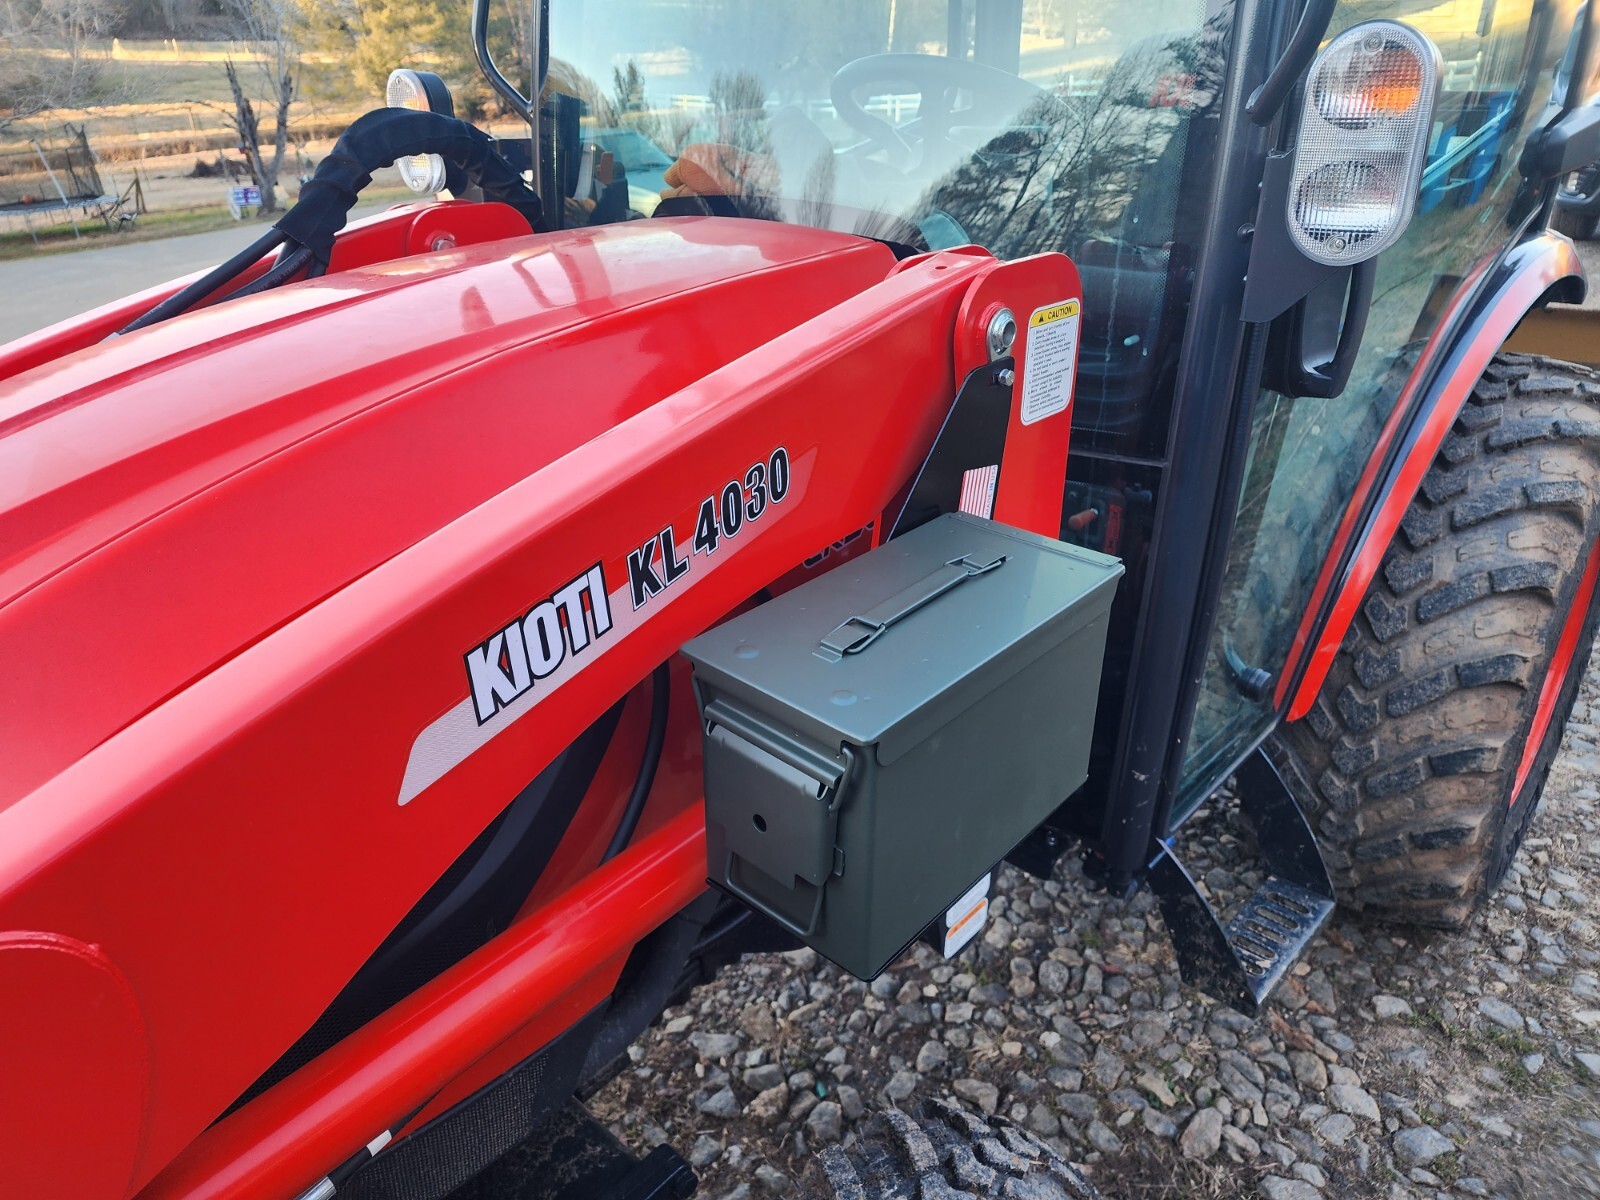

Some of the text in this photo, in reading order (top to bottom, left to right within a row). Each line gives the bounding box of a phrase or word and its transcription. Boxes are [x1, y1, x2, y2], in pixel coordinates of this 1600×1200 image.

[1047, 306, 1073, 320] CAUTION
[464, 561, 613, 727] KIOTI
[626, 525, 690, 612] KL
[693, 446, 791, 557] 4030
